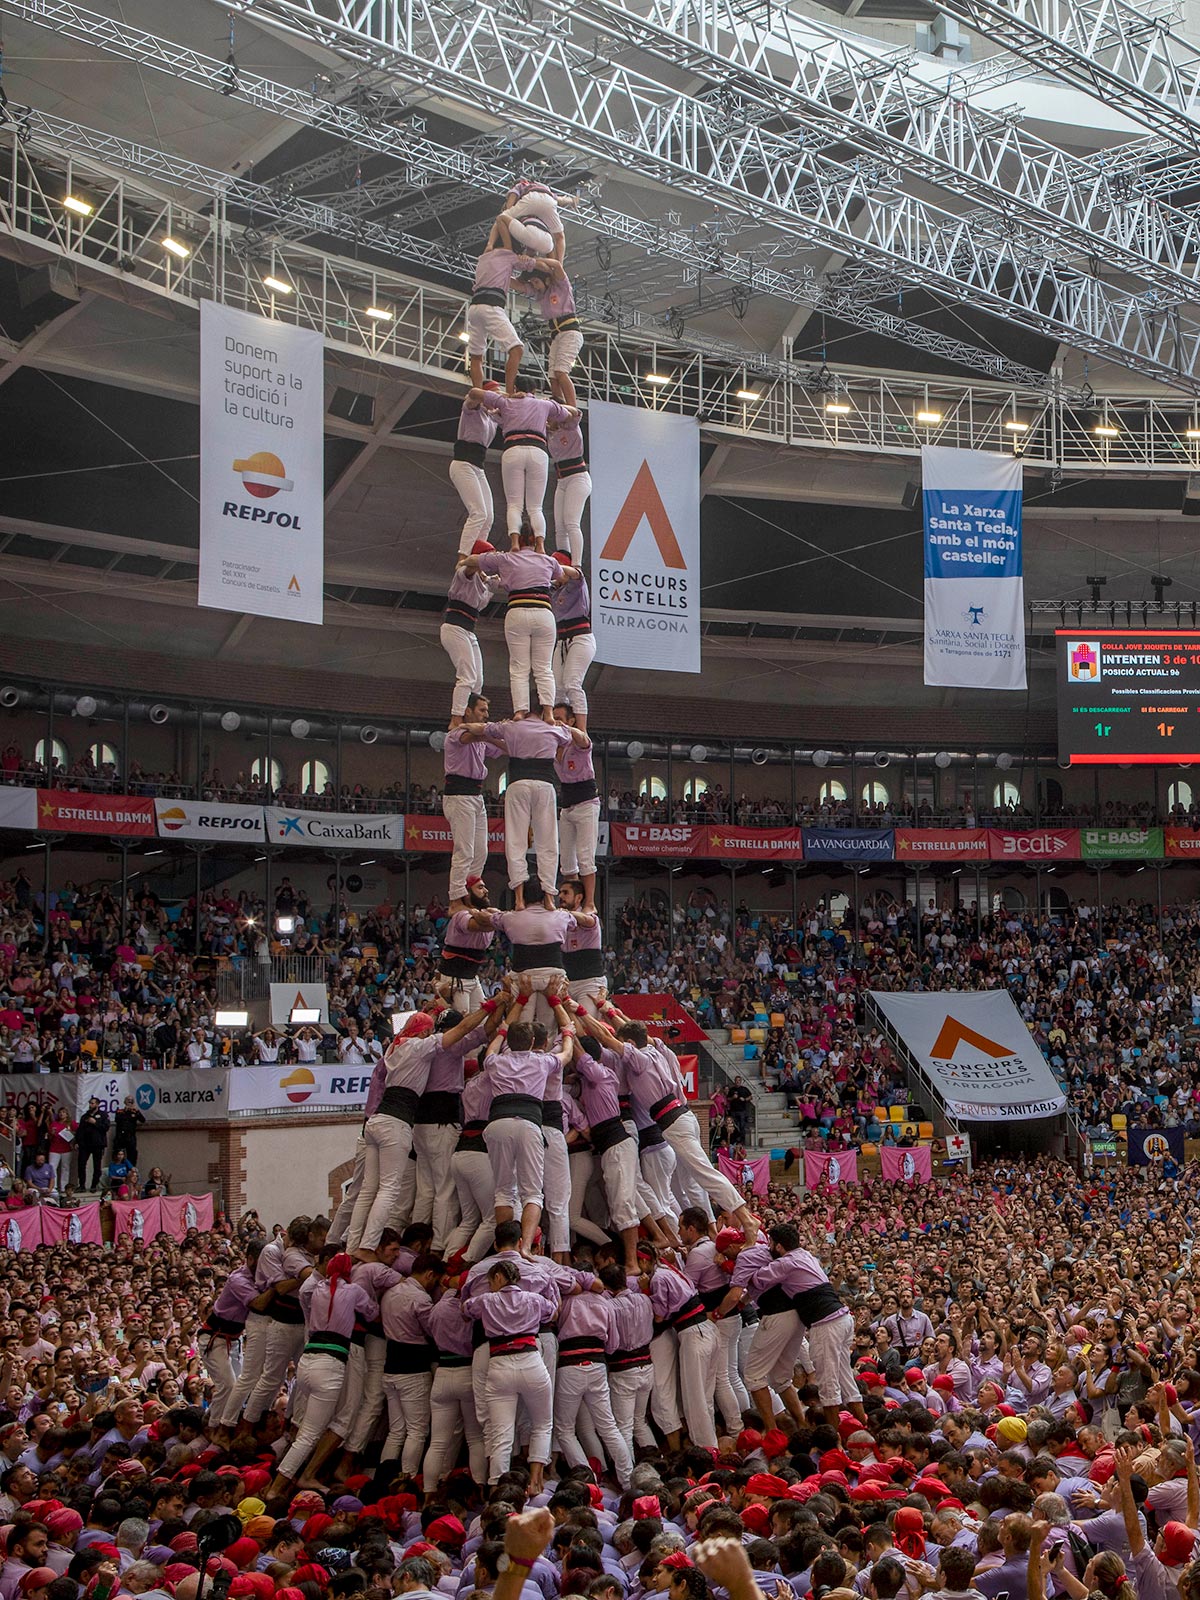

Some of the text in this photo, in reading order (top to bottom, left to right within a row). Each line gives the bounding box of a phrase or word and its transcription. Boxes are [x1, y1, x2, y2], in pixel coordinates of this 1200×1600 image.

[225, 336, 278, 364] Donem
[224, 360, 302, 390] suport a la
[224, 378, 288, 407] tradició i
[224, 398, 294, 428] la cultura
[222, 502, 302, 530] REPSOL
[942, 502, 1006, 518] La Xarxa
[930, 517, 1018, 538] Santa Tecla,
[930, 534, 1015, 550] amb el món
[942, 551, 1006, 565] casteller
[599, 568, 688, 592] CONCURS
[600, 586, 688, 608] CASTELLS
[600, 613, 688, 634] TARRAGONA
[936, 629, 1015, 642] XARXA SANTA TECLA
[964, 640, 988, 648] Social
[994, 641, 1020, 650] Docent
[945, 648, 972, 656] Tarragona
[994, 650, 1012, 658] 1171
[1102, 654, 1160, 664] INTENTEN
[1163, 655, 1171, 664] 3
[1173, 655, 1187, 664] de
[1094, 722, 1112, 736] 1r
[1157, 722, 1175, 736] 1r
[58, 807, 151, 824] ESTRELLA DAMM
[198, 816, 262, 830] REPSOL
[308, 820, 392, 840] CaixaBank
[422, 830, 453, 840] ESTRE
[650, 828, 692, 841] BASF
[1108, 832, 1148, 844] BASF
[661, 845, 693, 854] chemistry
[724, 838, 800, 850] ESTRELLA DAMM
[808, 838, 890, 850] LA VANGUARDIA
[912, 840, 986, 850] ESTRELLA DAMM
[1003, 834, 1052, 854] 3cat
[1119, 848, 1150, 856] chemistry
[932, 1058, 1023, 1071] CONCURS
[936, 1065, 1028, 1078] CASTELLS
[330, 1077, 373, 1094] REP
[944, 1077, 1036, 1090] TARRAGONA
[158, 1088, 171, 1103] la
[954, 1102, 1058, 1116] SERVEIS SANITARIS
[1094, 1142, 1116, 1150] SORTIDA
